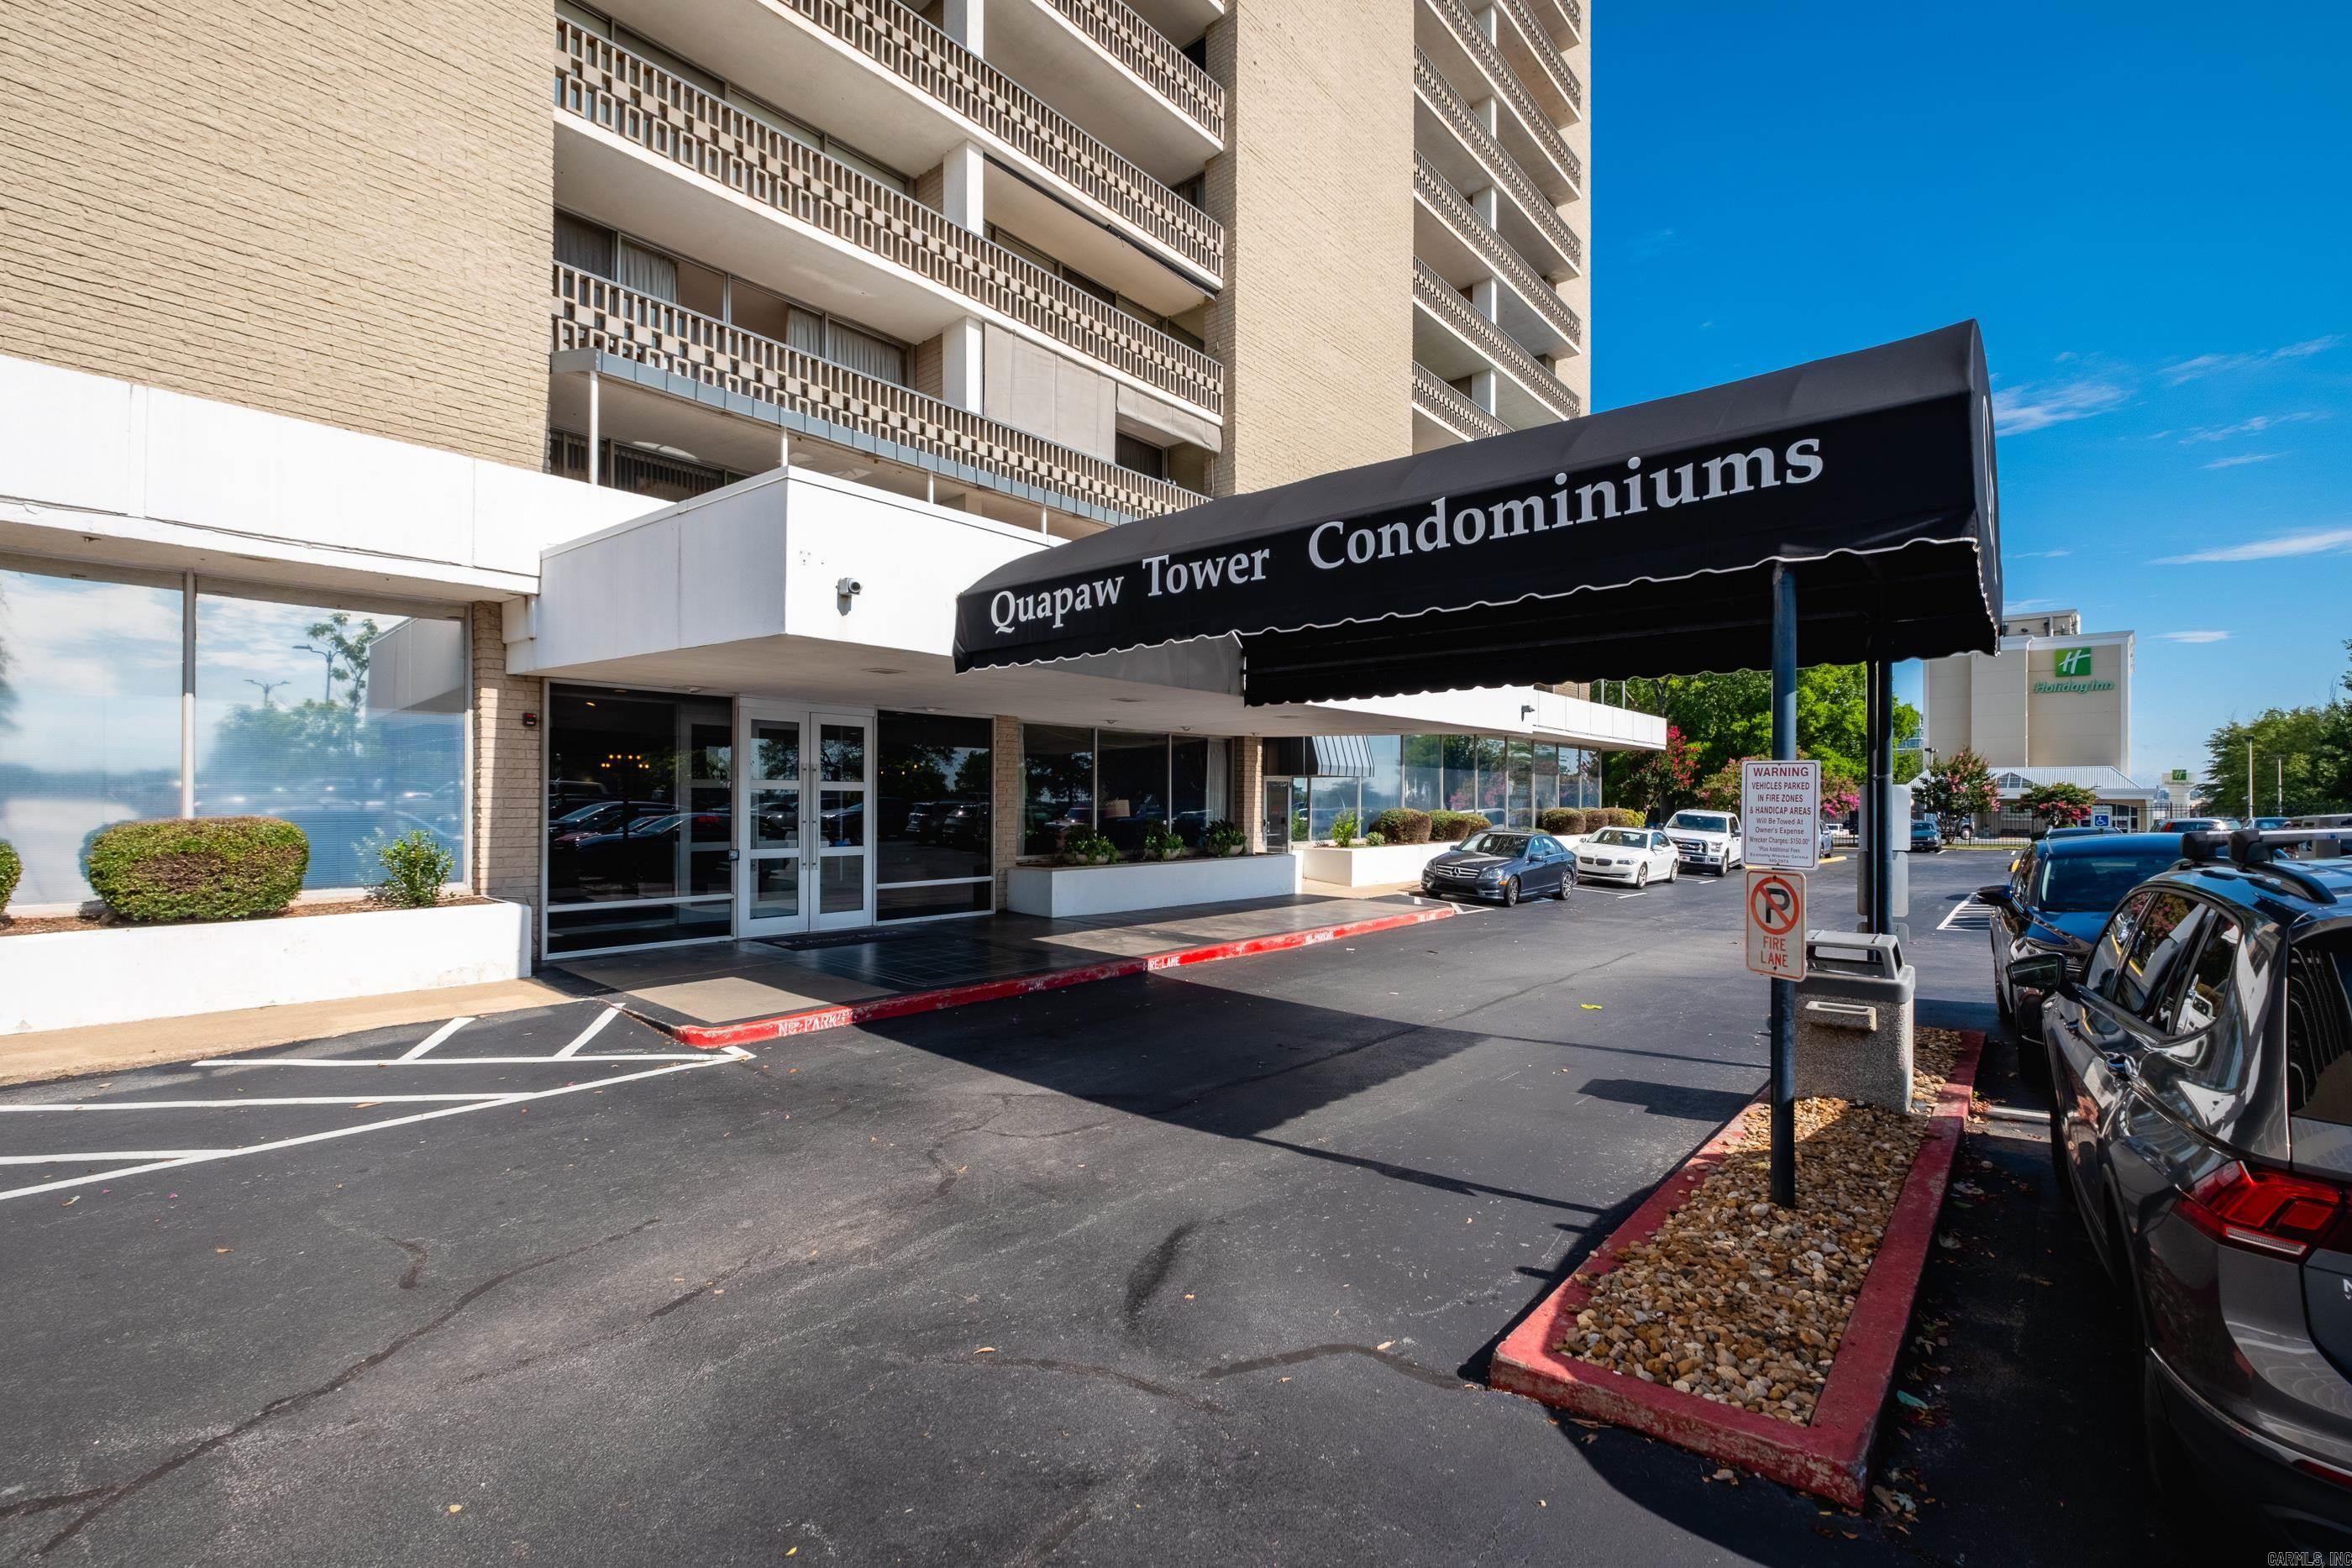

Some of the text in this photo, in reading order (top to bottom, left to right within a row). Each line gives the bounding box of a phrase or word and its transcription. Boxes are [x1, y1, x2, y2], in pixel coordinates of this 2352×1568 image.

[990, 438, 1824, 634] Quapaw Tower Condominiums
[2034, 679, 2115, 695] Holiday Inn
[1753, 767, 1809, 777] WARNING
[1751, 782, 1810, 790] VEHICLES PARKED
[1781, 794, 1803, 803] ZONES
[1755, 806, 1788, 815] HANDICAP
[1789, 806, 1812, 815] AREAS
[1755, 826, 1804, 836] Owner's Expense
[1763, 936, 1786, 952] FIRE
[1161, 956, 1180, 968] LANE
[1761, 951, 1788, 968] LANE
